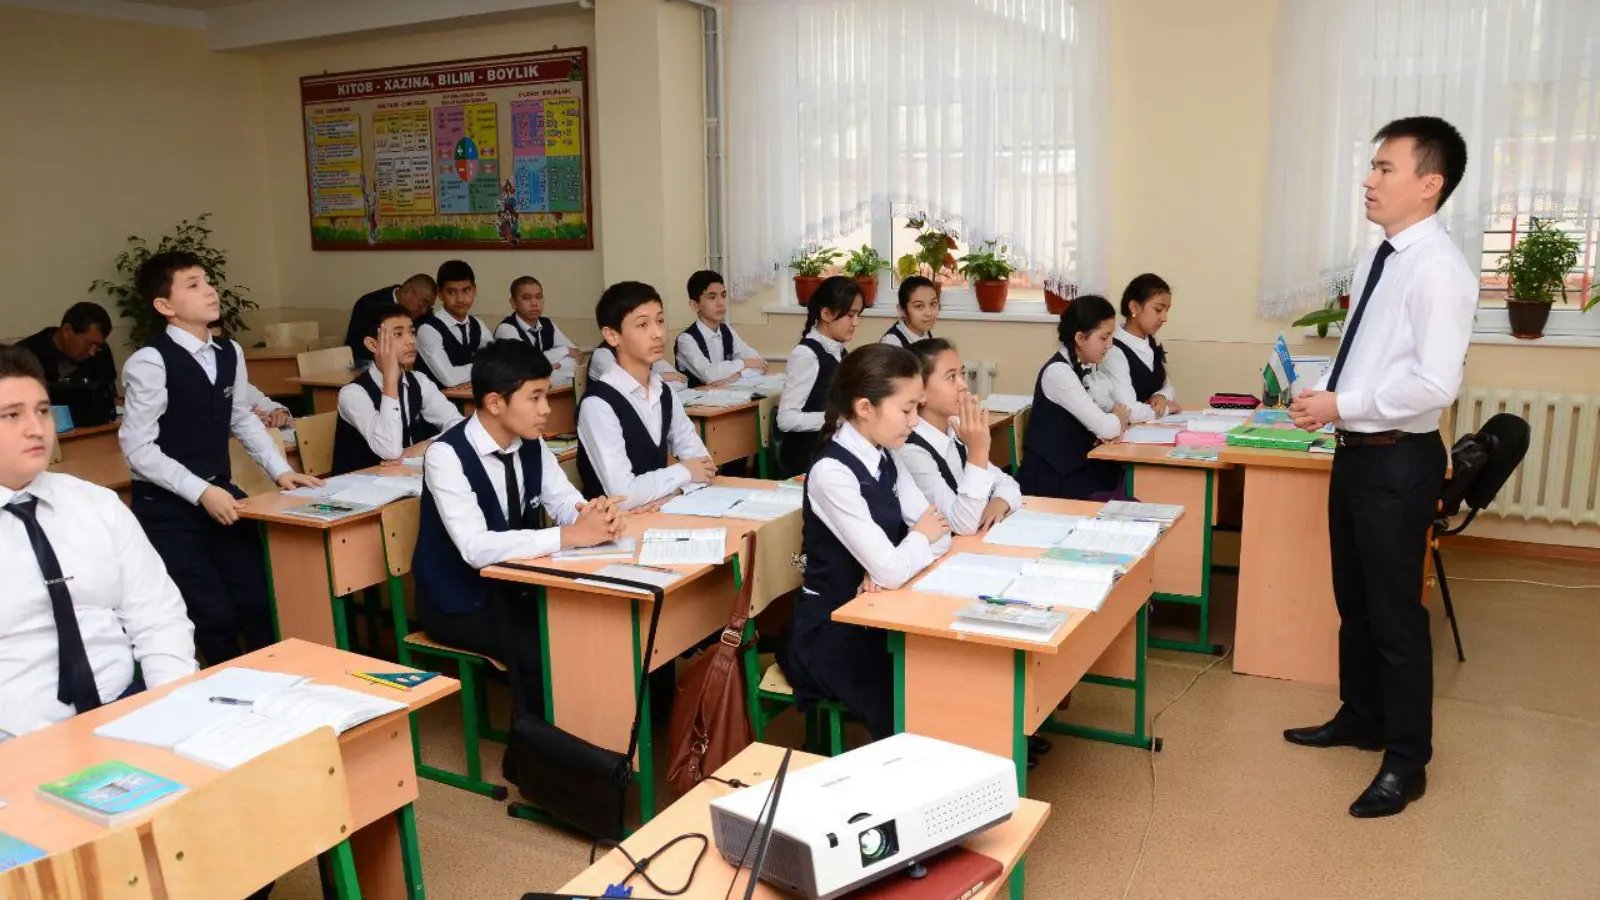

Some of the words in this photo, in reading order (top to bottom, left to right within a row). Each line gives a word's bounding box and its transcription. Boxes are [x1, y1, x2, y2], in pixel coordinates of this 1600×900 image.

[337, 83, 373, 95] KITOB
[384, 76, 435, 92] XAZINA,
[438, 71, 475, 86] BILIM
[487, 66, 539, 82] BOYLIK
